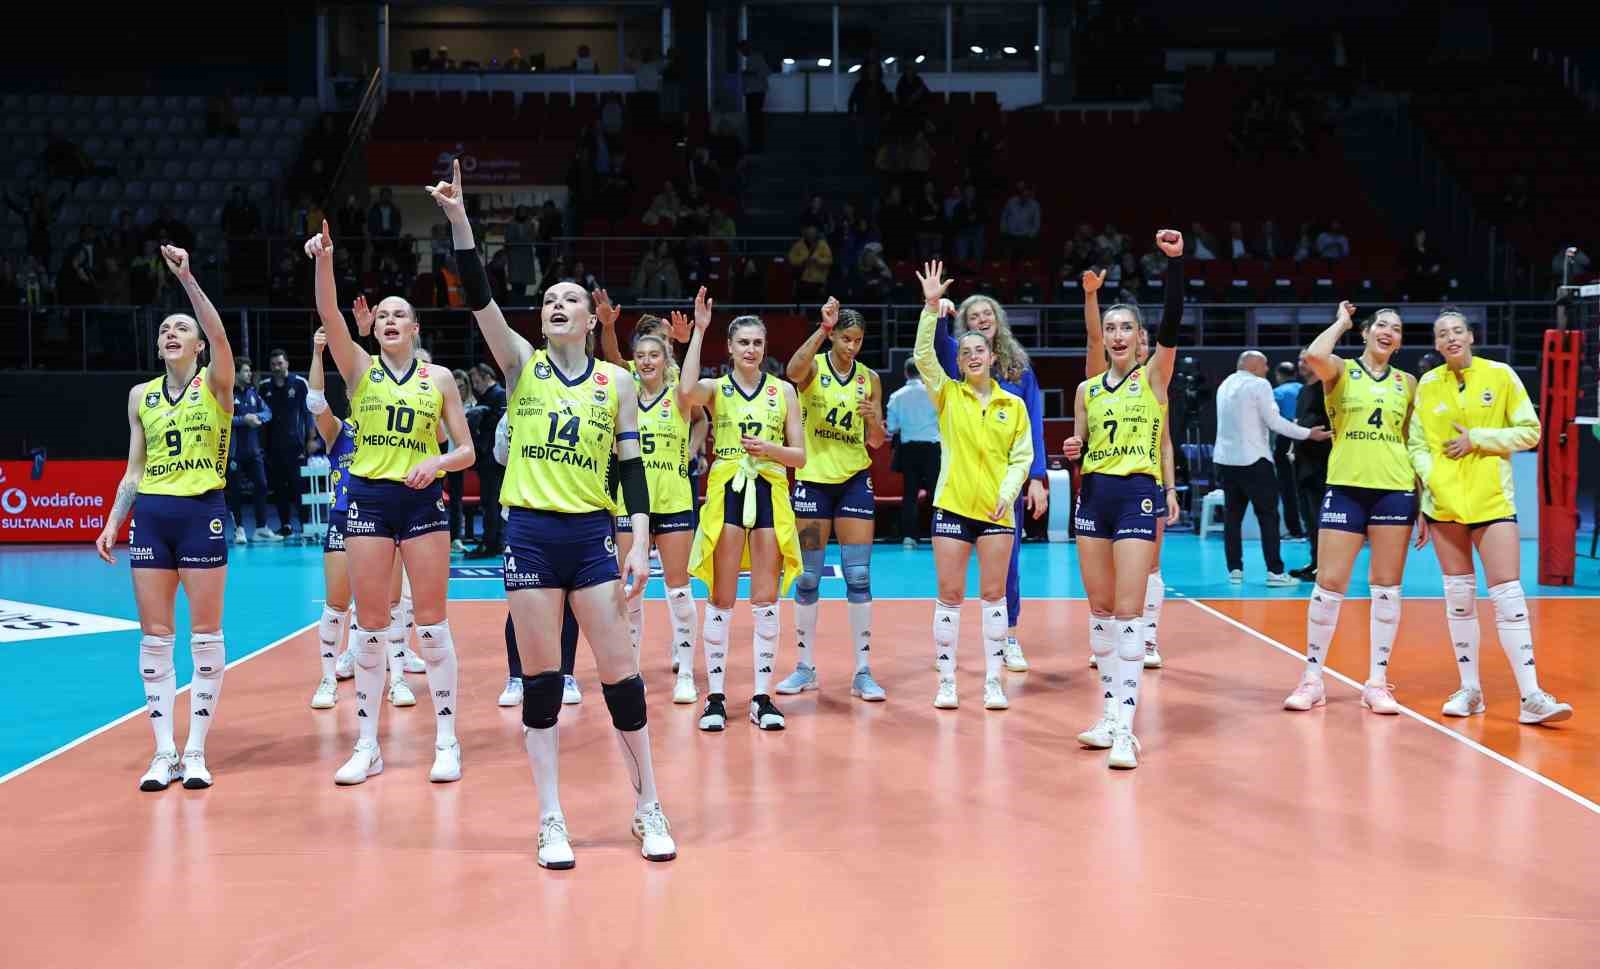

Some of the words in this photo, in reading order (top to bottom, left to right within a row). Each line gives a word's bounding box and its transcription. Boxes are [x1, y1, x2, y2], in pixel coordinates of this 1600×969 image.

[386, 405, 415, 434] 10
[548, 411, 580, 447] 14
[825, 407, 853, 431] 44
[1367, 407, 1383, 429] 4
[738, 422, 763, 439] 17
[1103, 420, 1117, 444] 7
[165, 430, 181, 457] 9
[31, 493, 104, 507] vodafone
[1, 518, 74, 529] SULTANLAR
[79, 515, 104, 529] LİGİ
